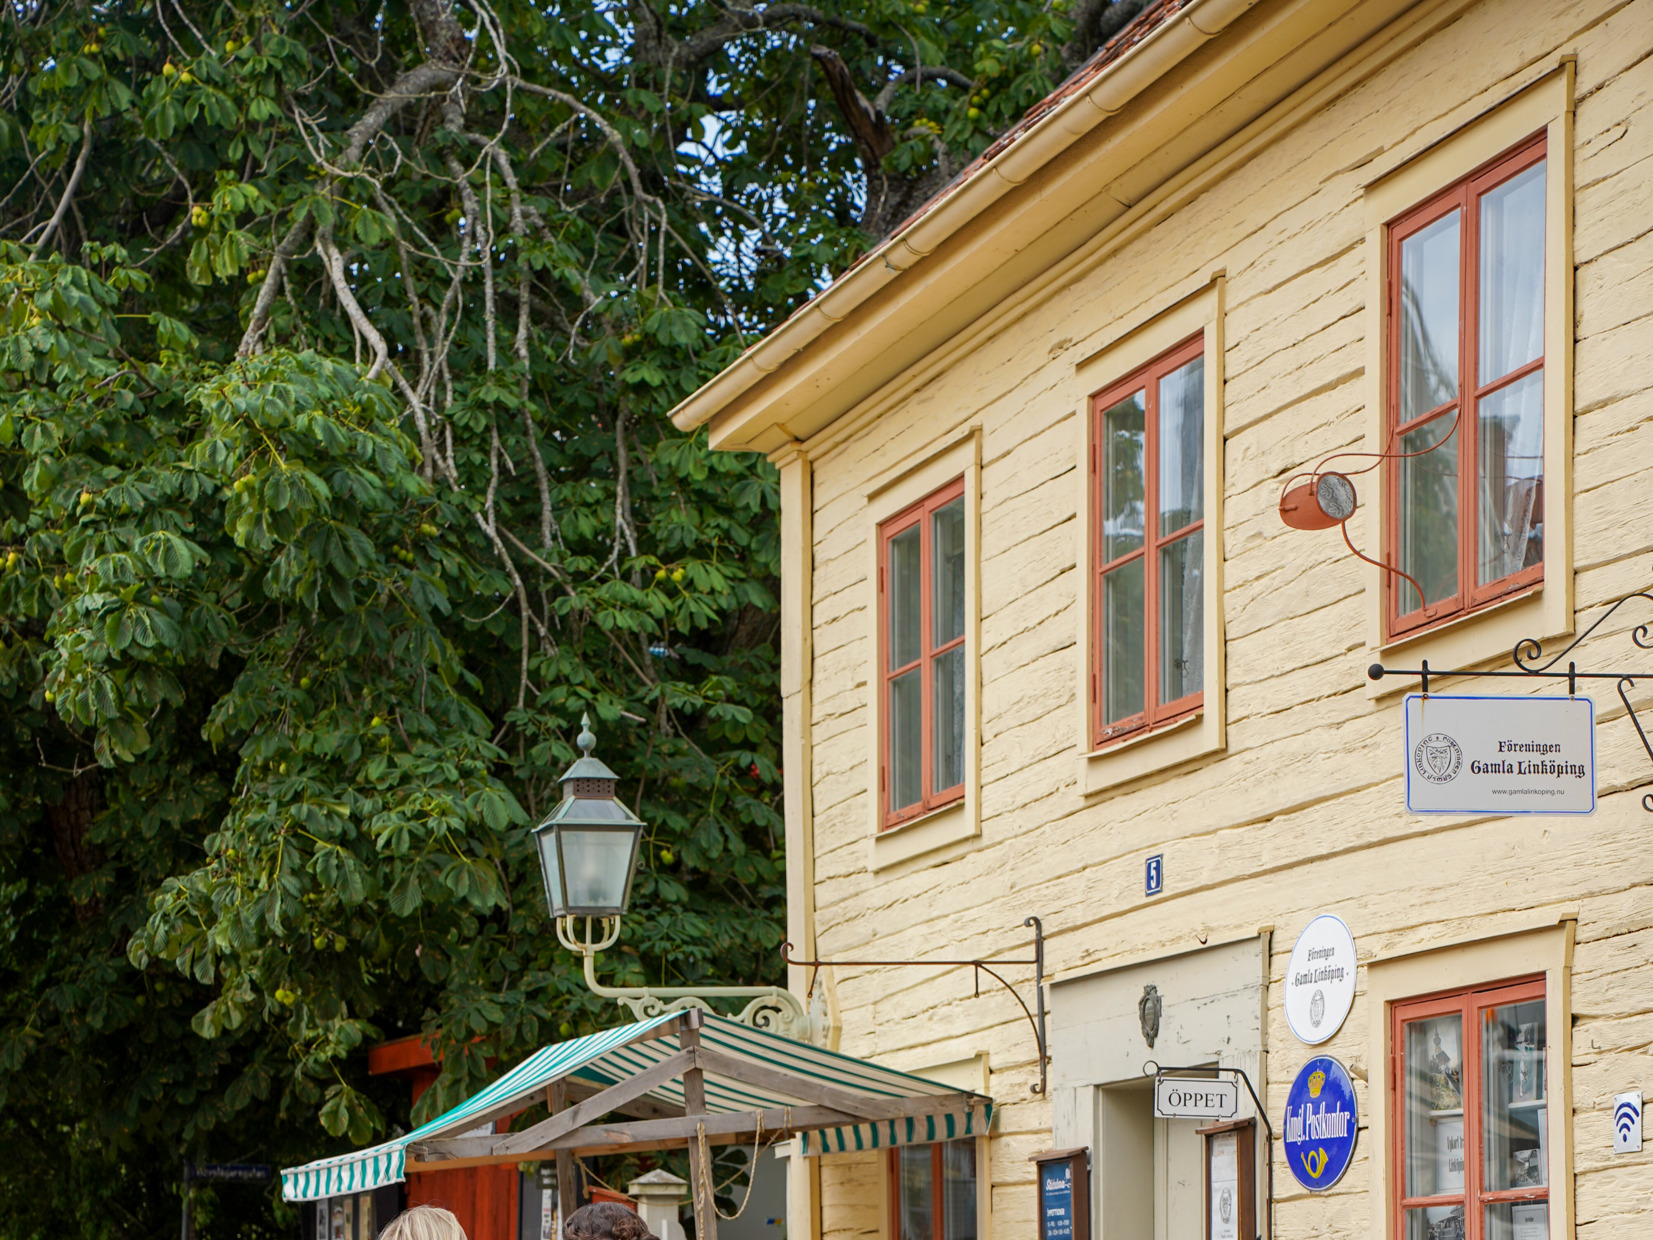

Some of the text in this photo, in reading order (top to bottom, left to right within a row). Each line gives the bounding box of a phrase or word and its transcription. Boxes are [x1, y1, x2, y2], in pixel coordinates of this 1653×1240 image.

[1497, 740, 1561, 756] Föreningen
[1470, 760, 1586, 779] Gamla Linköping
[1491, 788, 1565, 796] www.gamlalinkoping.nu
[1150, 861, 1157, 889] 5
[1307, 946, 1335, 962] Föreningen
[1295, 964, 1345, 988] Gamla Linköping
[1168, 1088, 1228, 1108] ÖPPET
[1305, 1101, 1350, 1140] Postkontor
